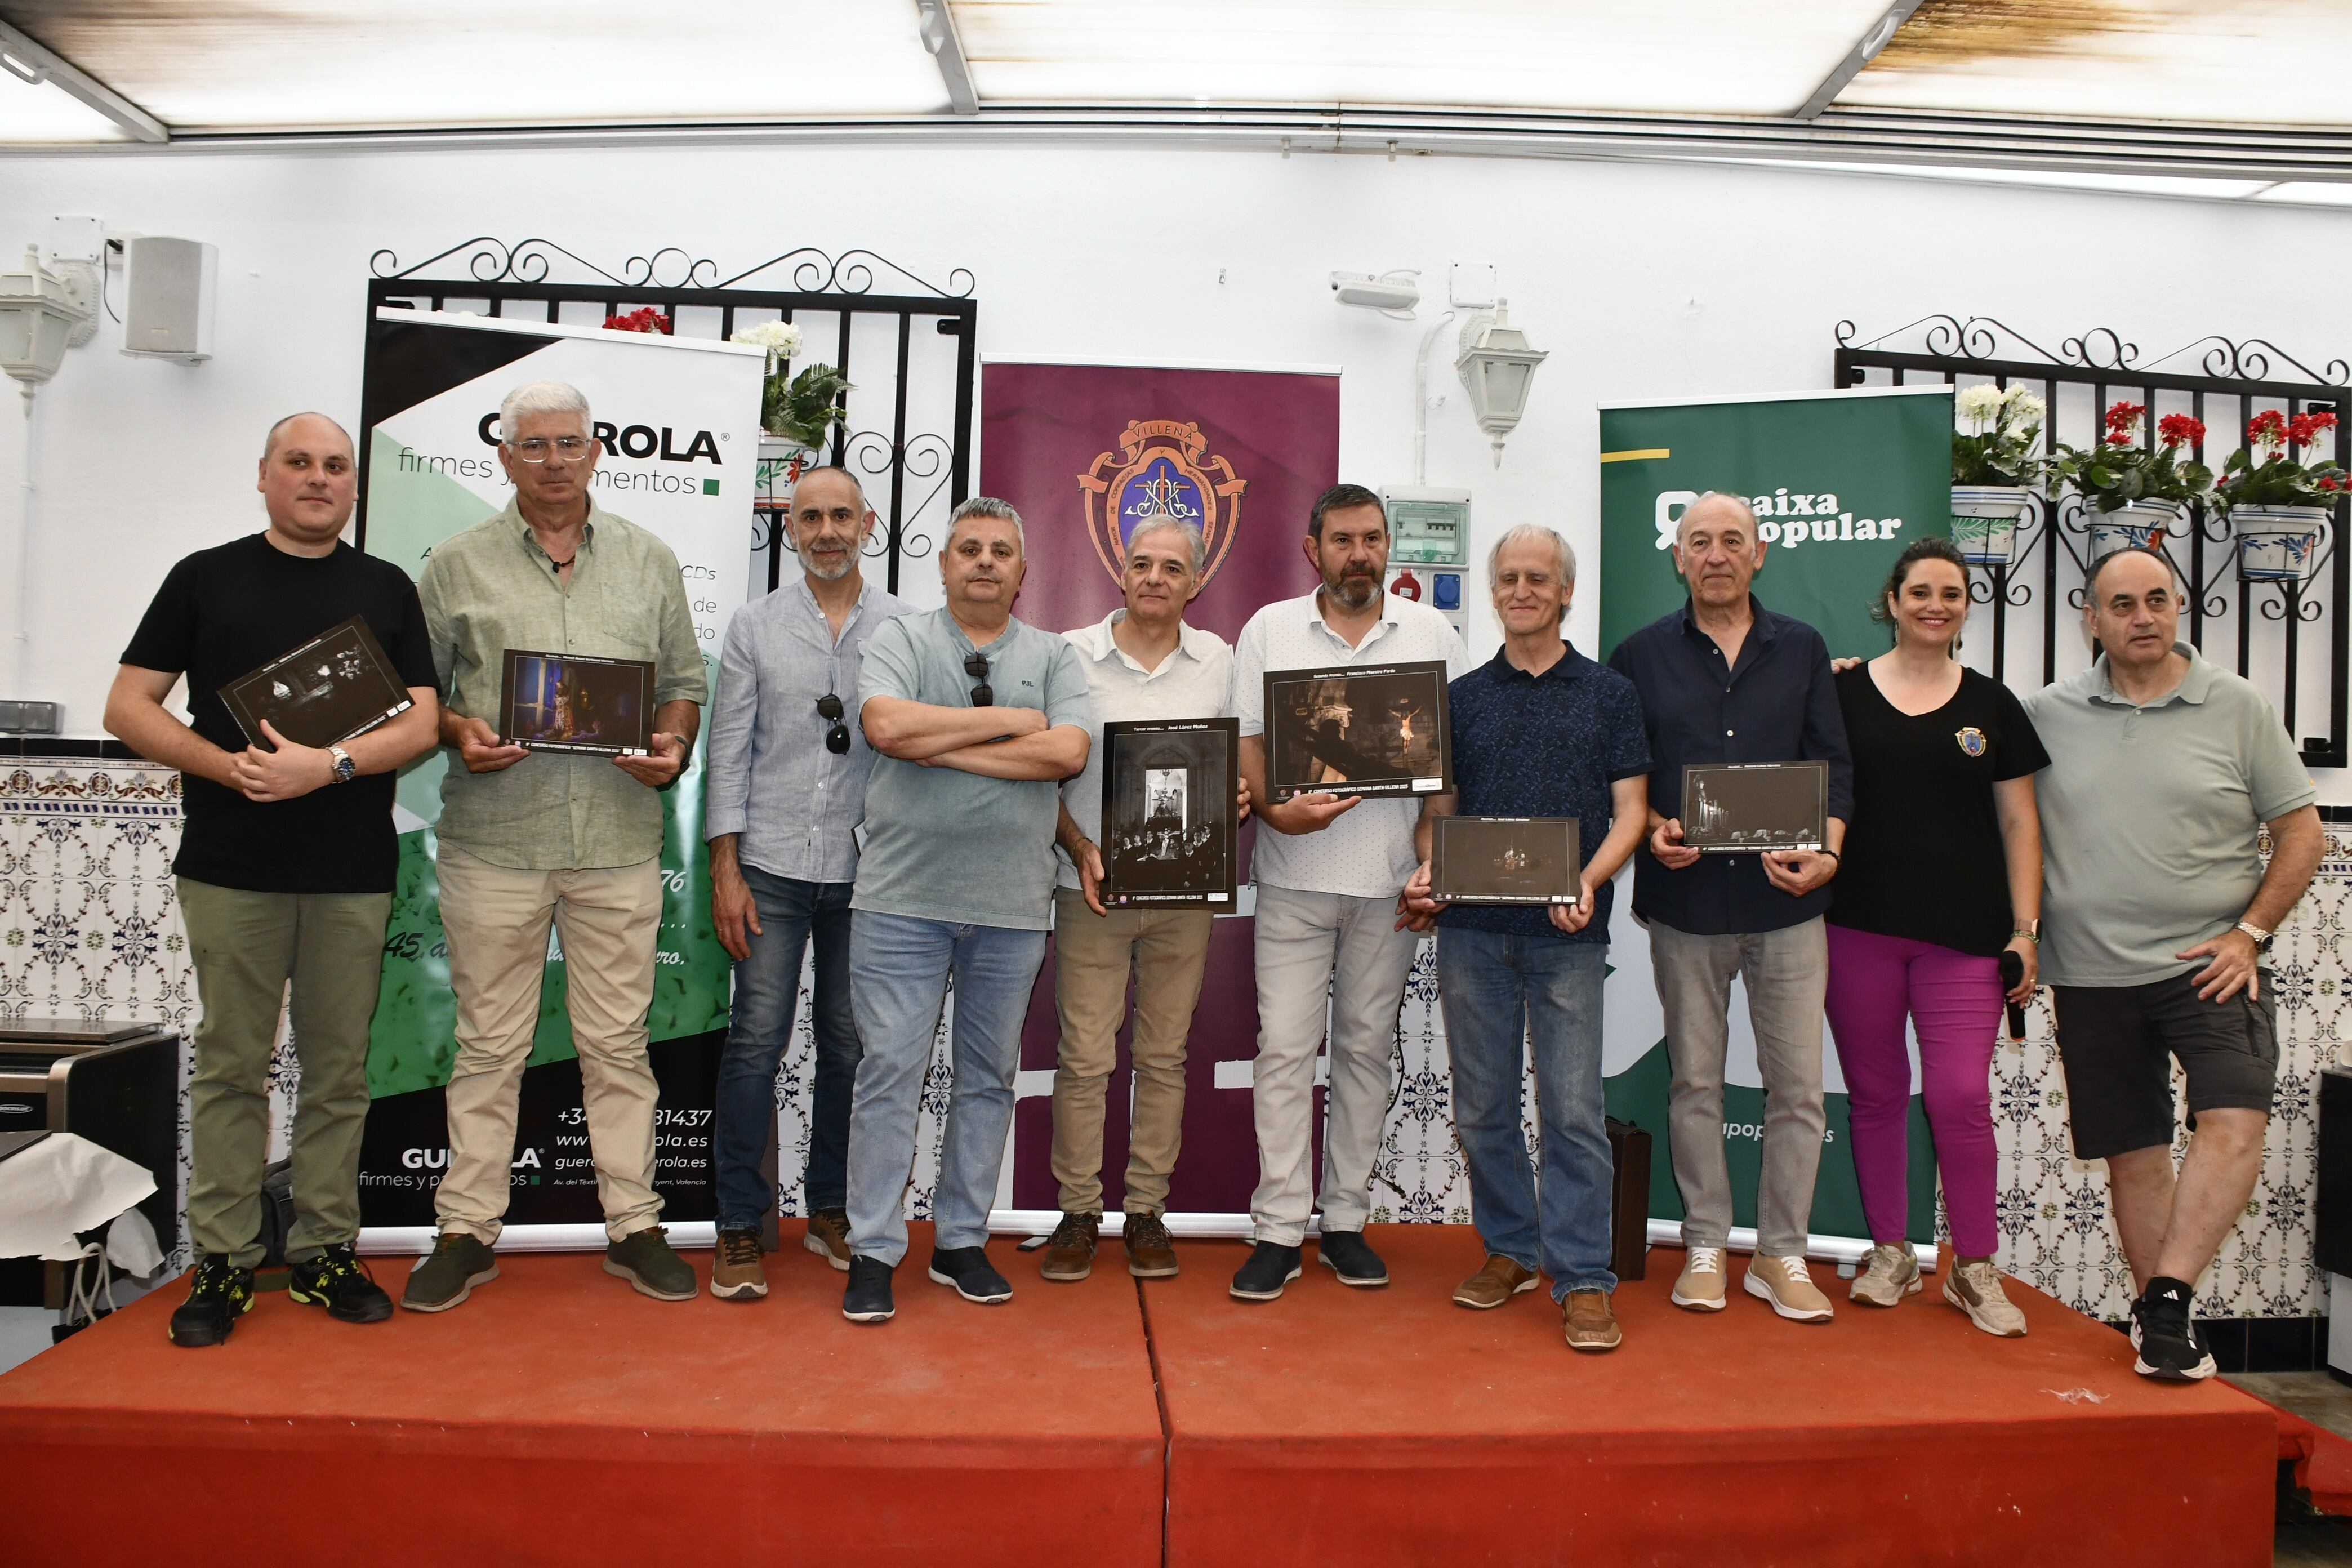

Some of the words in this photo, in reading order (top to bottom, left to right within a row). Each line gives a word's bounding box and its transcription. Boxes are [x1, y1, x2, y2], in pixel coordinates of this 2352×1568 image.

[478, 412, 723, 465] GROLA
[1133, 425, 1192, 441] VILLENA
[398, 447, 493, 478] firmes
[593, 469, 696, 495] mentos
[1752, 488, 1839, 517] aixa
[1204, 521, 1213, 544] SEMAN
[1758, 512, 1903, 549] opular
[693, 596, 717, 613] de
[385, 931, 424, 958] 45
[358, 1171, 412, 1186] firmes
[416, 1175, 426, 1190] y
